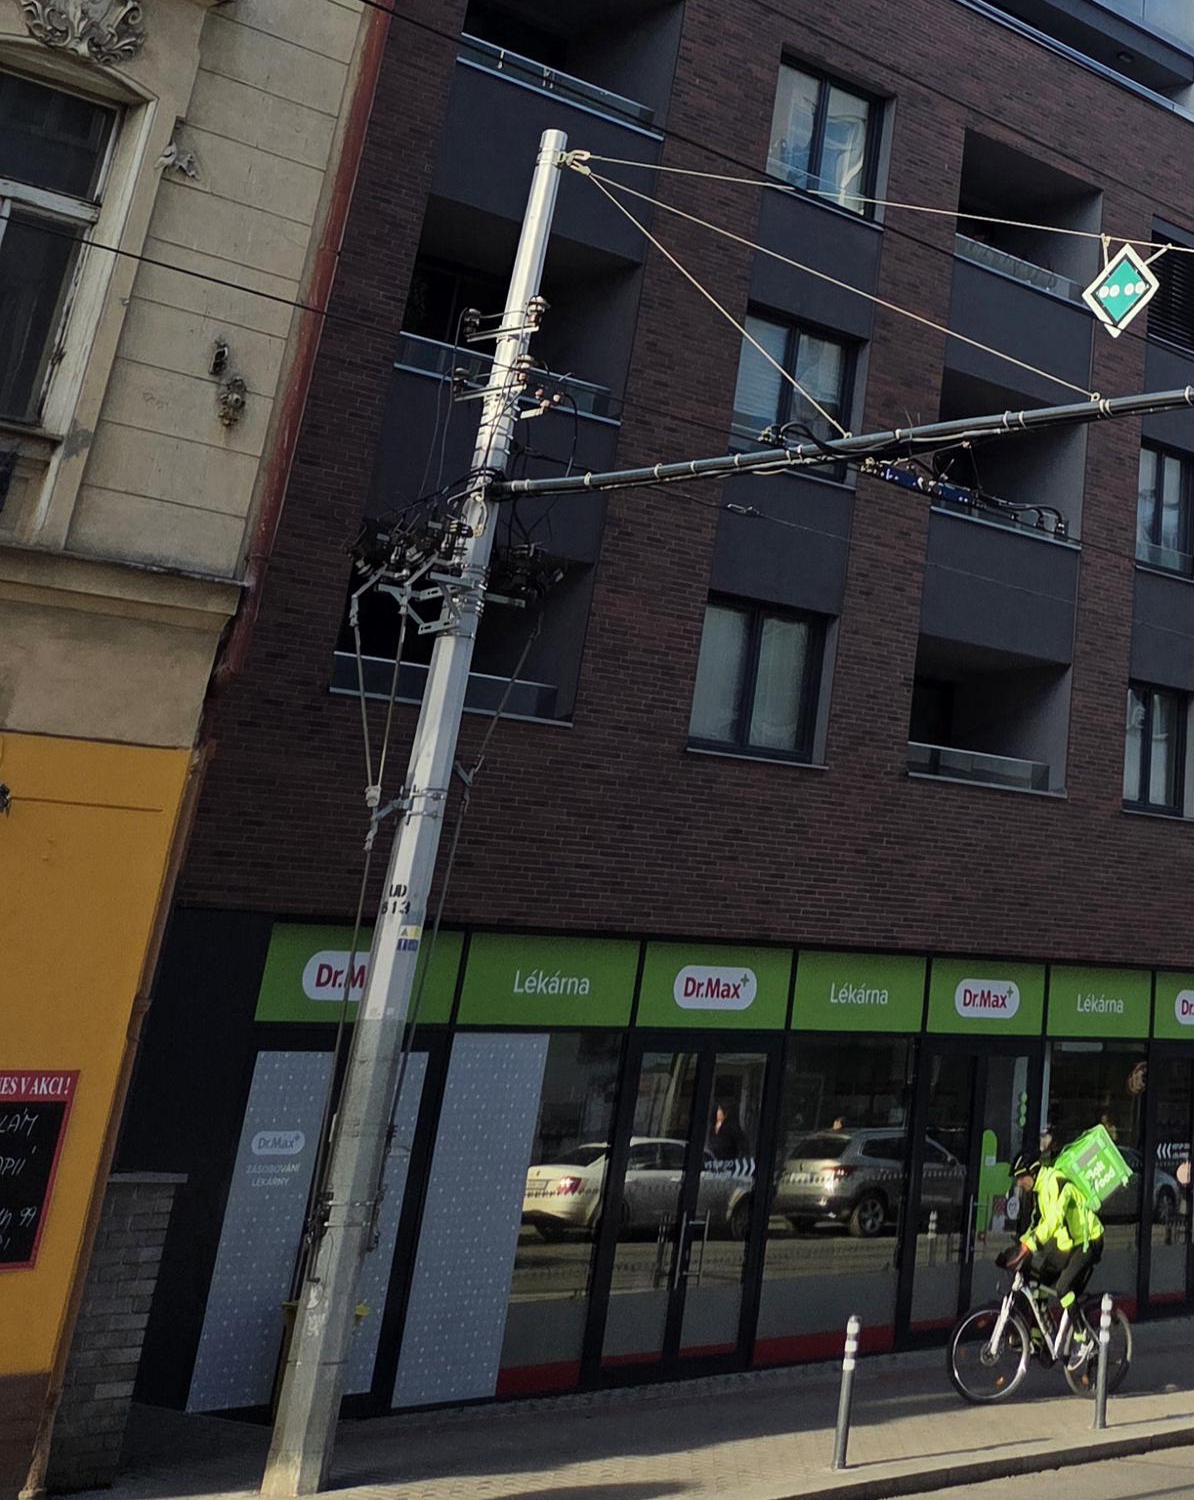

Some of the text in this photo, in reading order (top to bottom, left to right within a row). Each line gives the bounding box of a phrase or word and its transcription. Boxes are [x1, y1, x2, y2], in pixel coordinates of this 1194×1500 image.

[315, 963, 366, 989] Dr.M
[513, 969, 590, 996] Lékárna
[830, 982, 888, 1005] Lékárna
[1077, 994, 1124, 1014] Lékárna
[0, 1077, 18, 1095] ES
[21, 1077, 31, 1095] V
